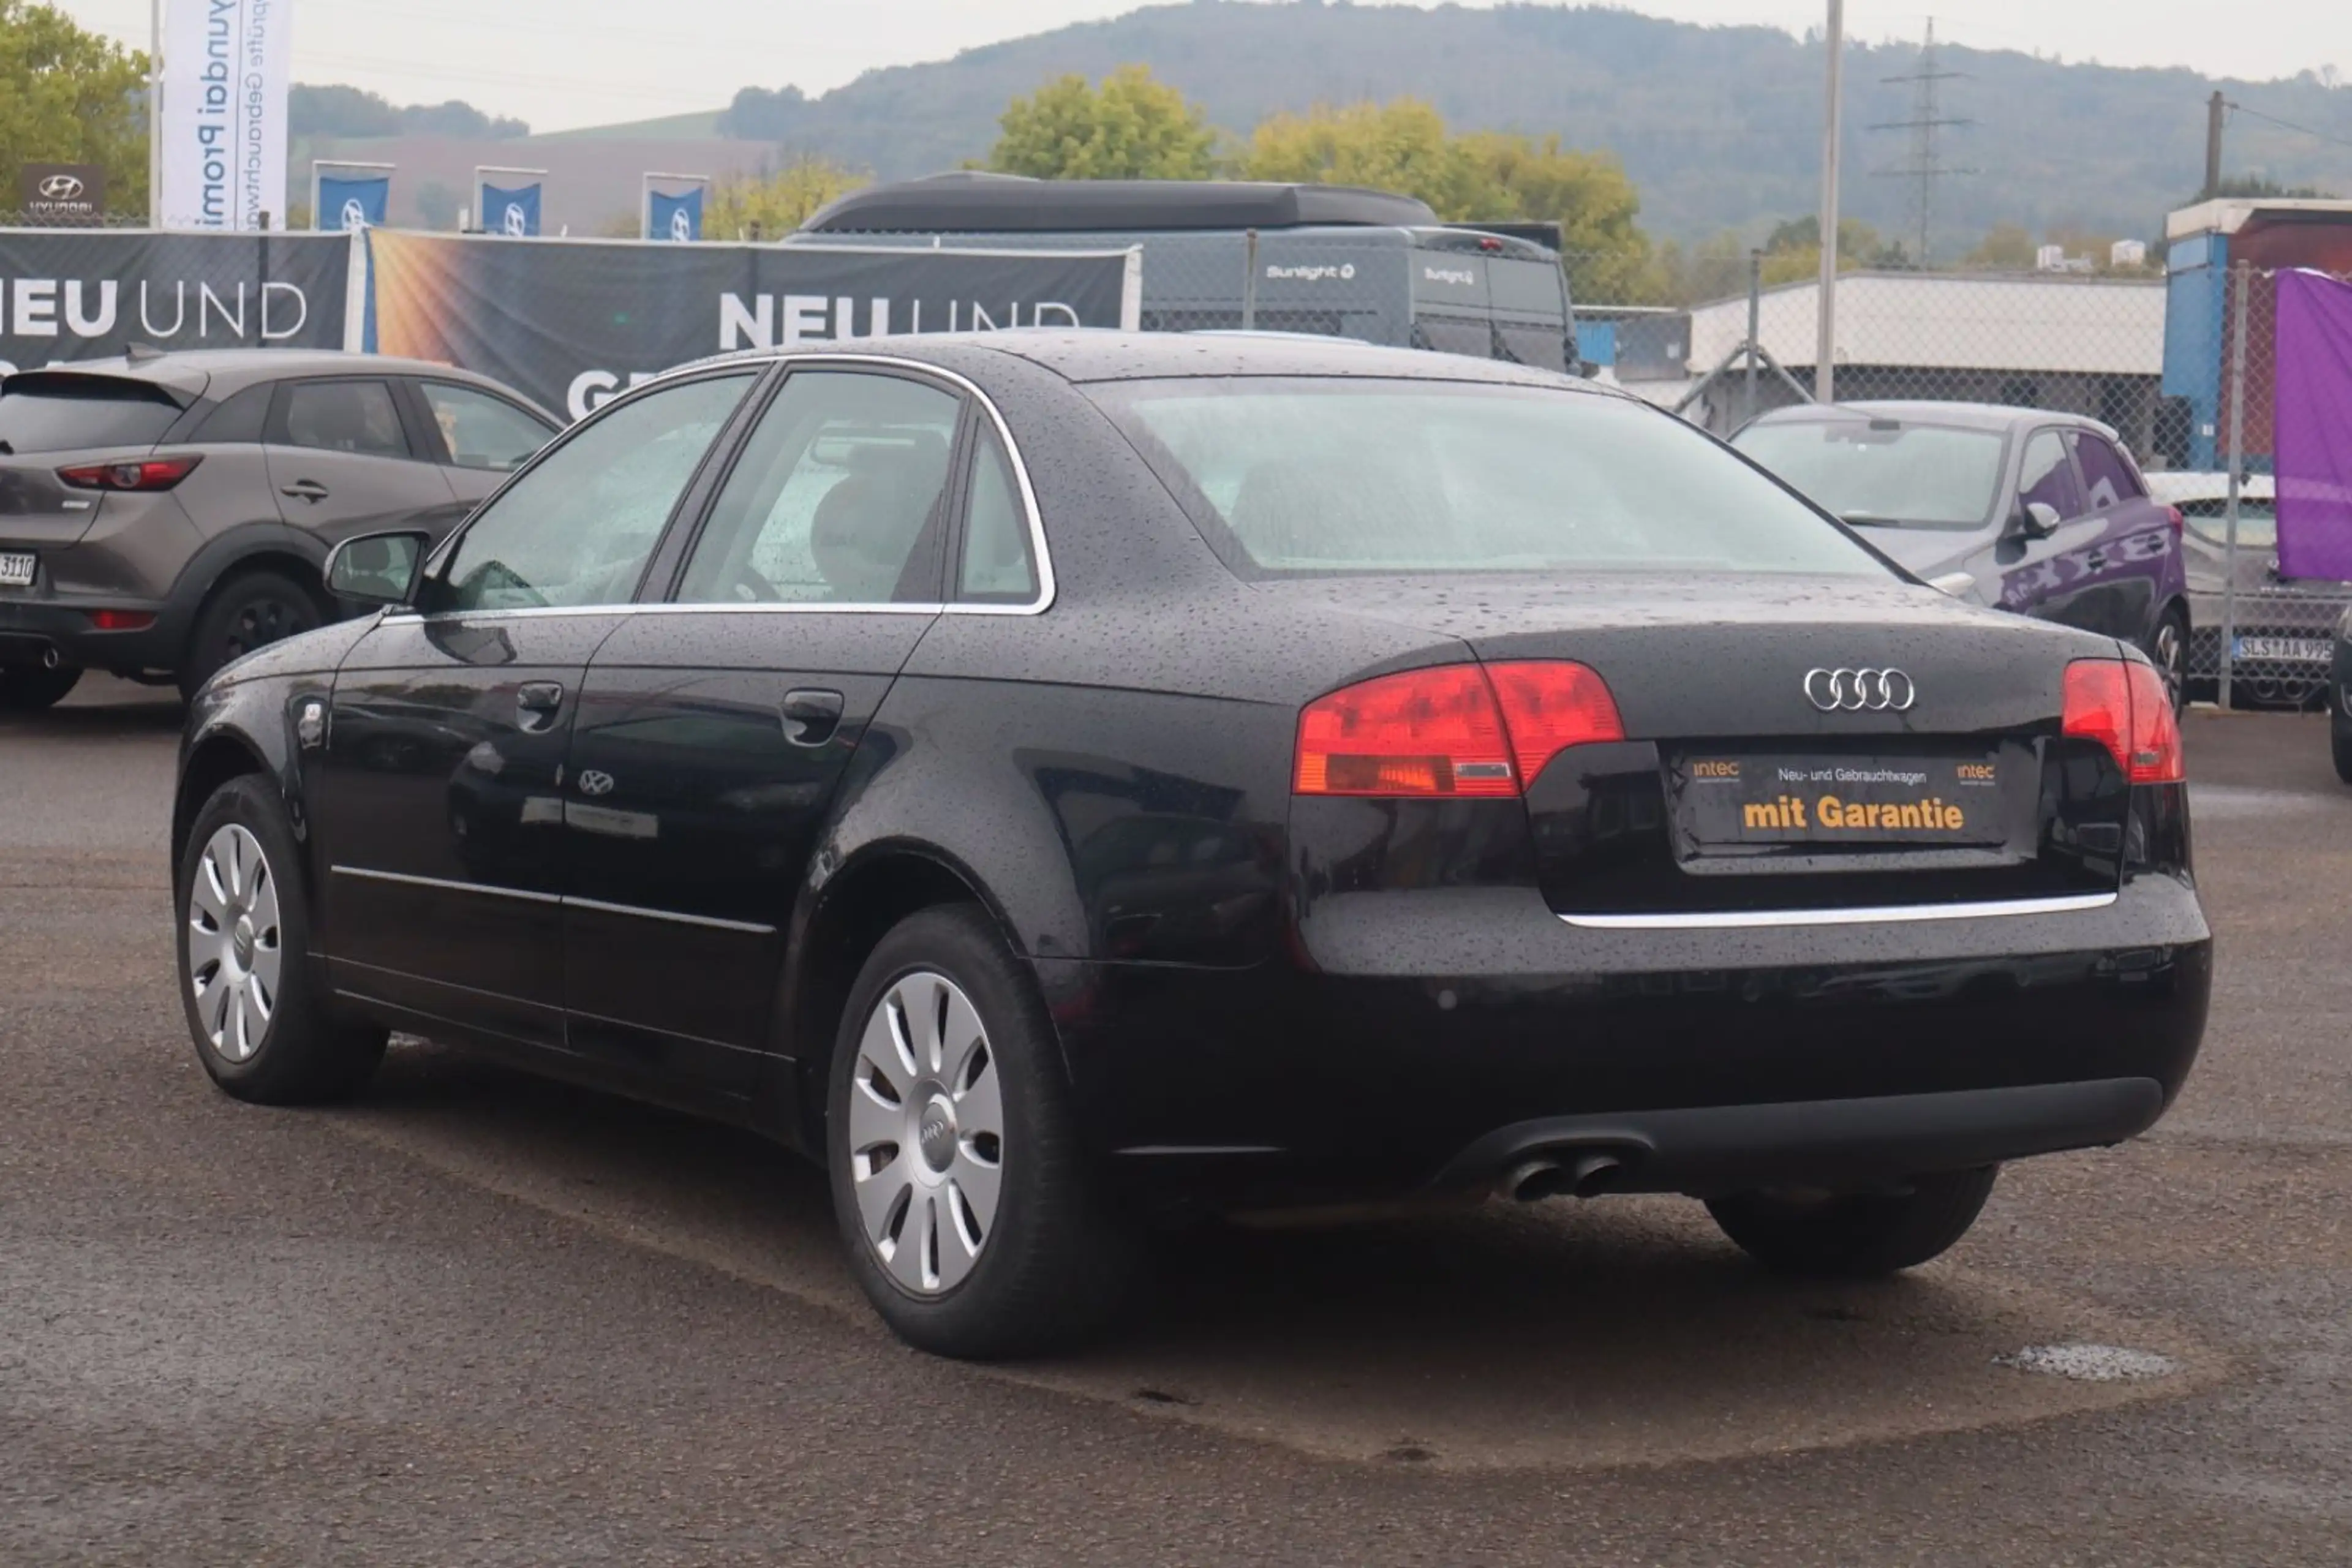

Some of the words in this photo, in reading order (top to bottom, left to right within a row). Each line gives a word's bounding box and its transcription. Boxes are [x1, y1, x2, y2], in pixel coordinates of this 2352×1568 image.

[1267, 265, 1337, 281] Sunlight
[0, 279, 118, 337] EU
[140, 280, 307, 339] UND
[719, 293, 889, 349] NEU
[1693, 761, 1740, 777] intec
[1779, 768, 1808, 782] Neu-
[1811, 769, 1833, 782] und
[1836, 768, 1927, 786] Gebrauchtwagen
[1957, 764, 1995, 779] intec
[1744, 795, 1806, 827] mit
[1817, 796, 1964, 830] Garantie
